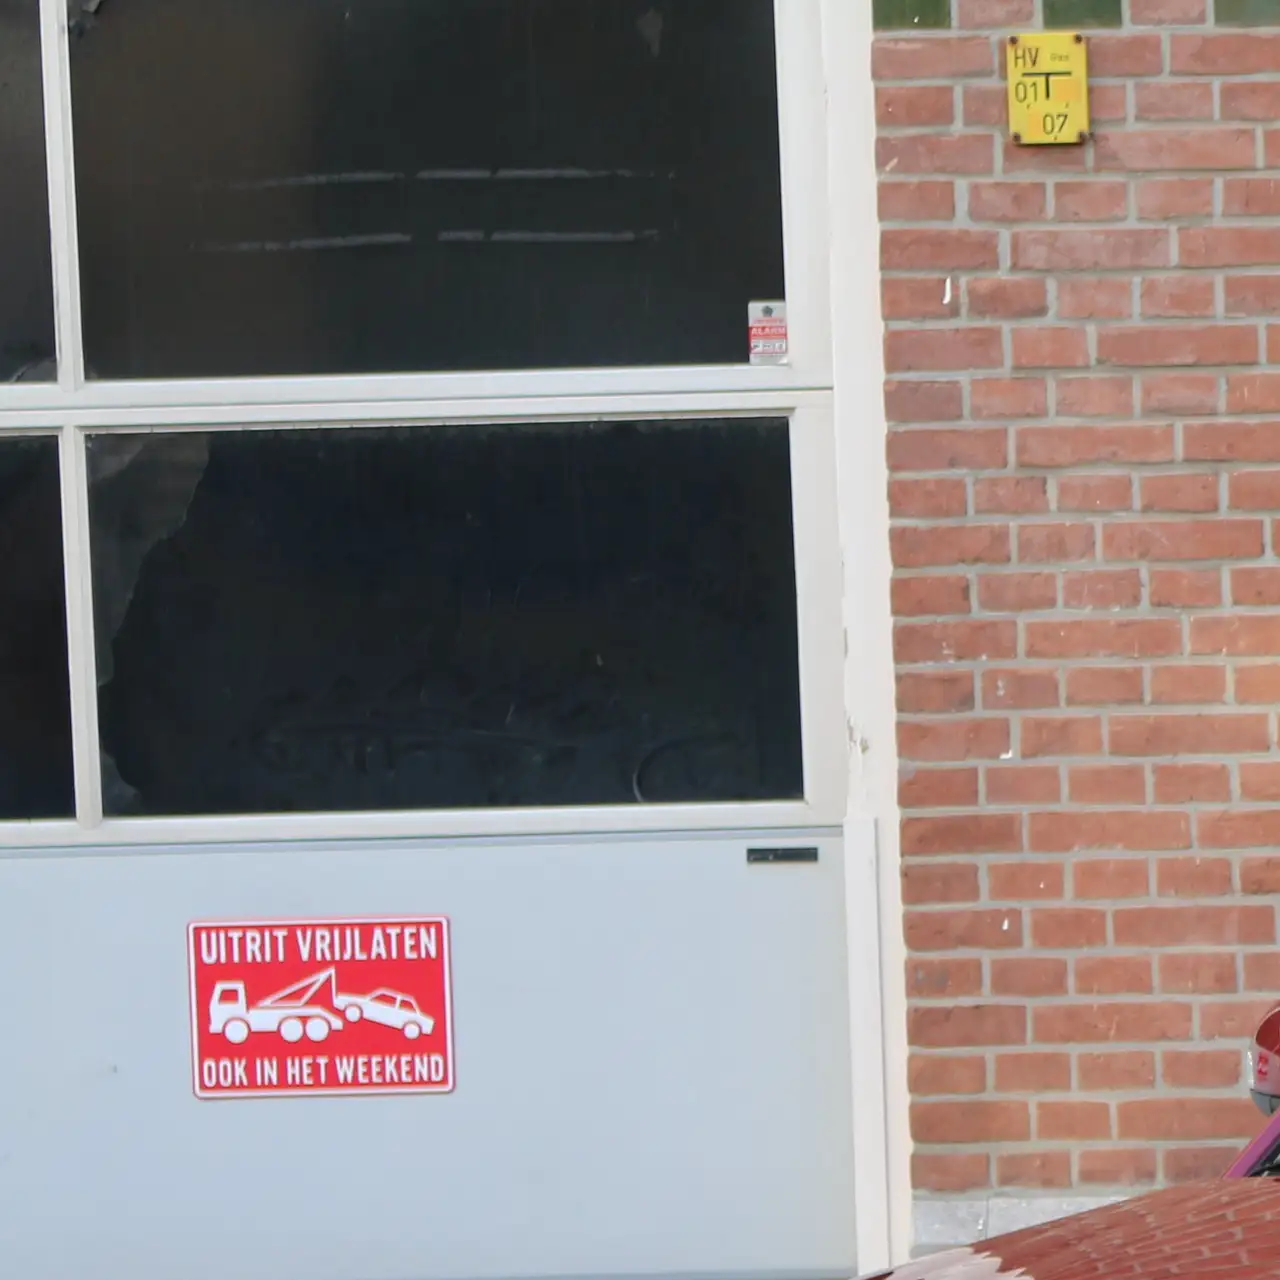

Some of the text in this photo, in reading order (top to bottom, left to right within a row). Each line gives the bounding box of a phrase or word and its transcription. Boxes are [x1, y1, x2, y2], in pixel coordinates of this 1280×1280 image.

[1013, 47, 1039, 69] HV
[1014, 81, 1038, 103] 01
[1042, 113, 1069, 135] 07
[201, 925, 438, 965] UITRIT VRIJLATEN
[203, 1052, 445, 1088] OOK IN HET WEEKEND
